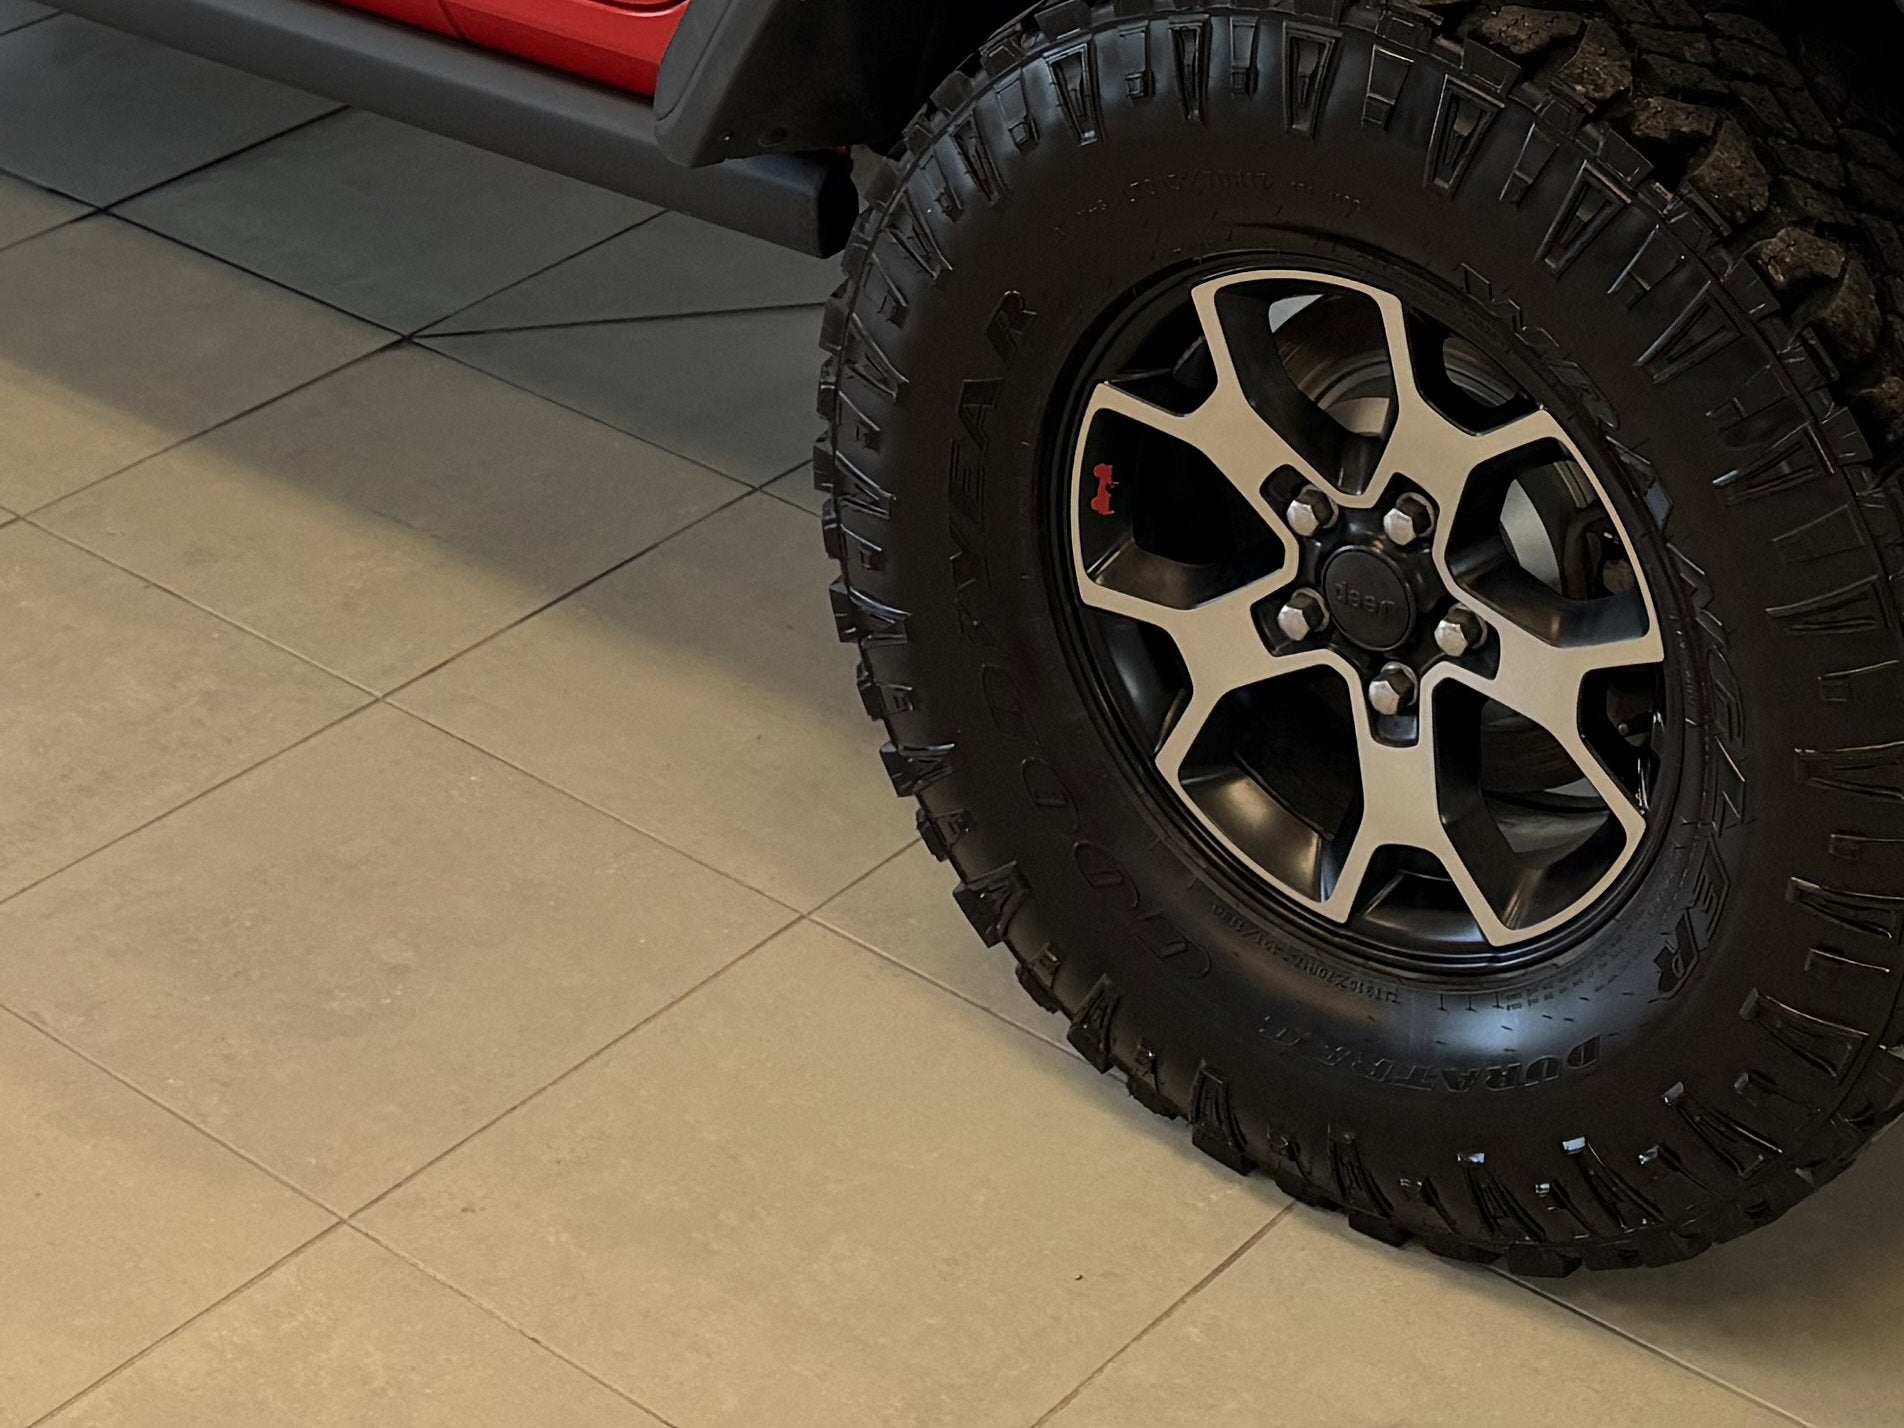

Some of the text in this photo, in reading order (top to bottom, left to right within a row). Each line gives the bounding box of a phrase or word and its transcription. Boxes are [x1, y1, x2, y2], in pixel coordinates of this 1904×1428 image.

[948, 289, 1213, 979] GOODYEAR
[1335, 582, 1396, 626] Jeep
[1458, 259, 1746, 1000] WRANGLER
